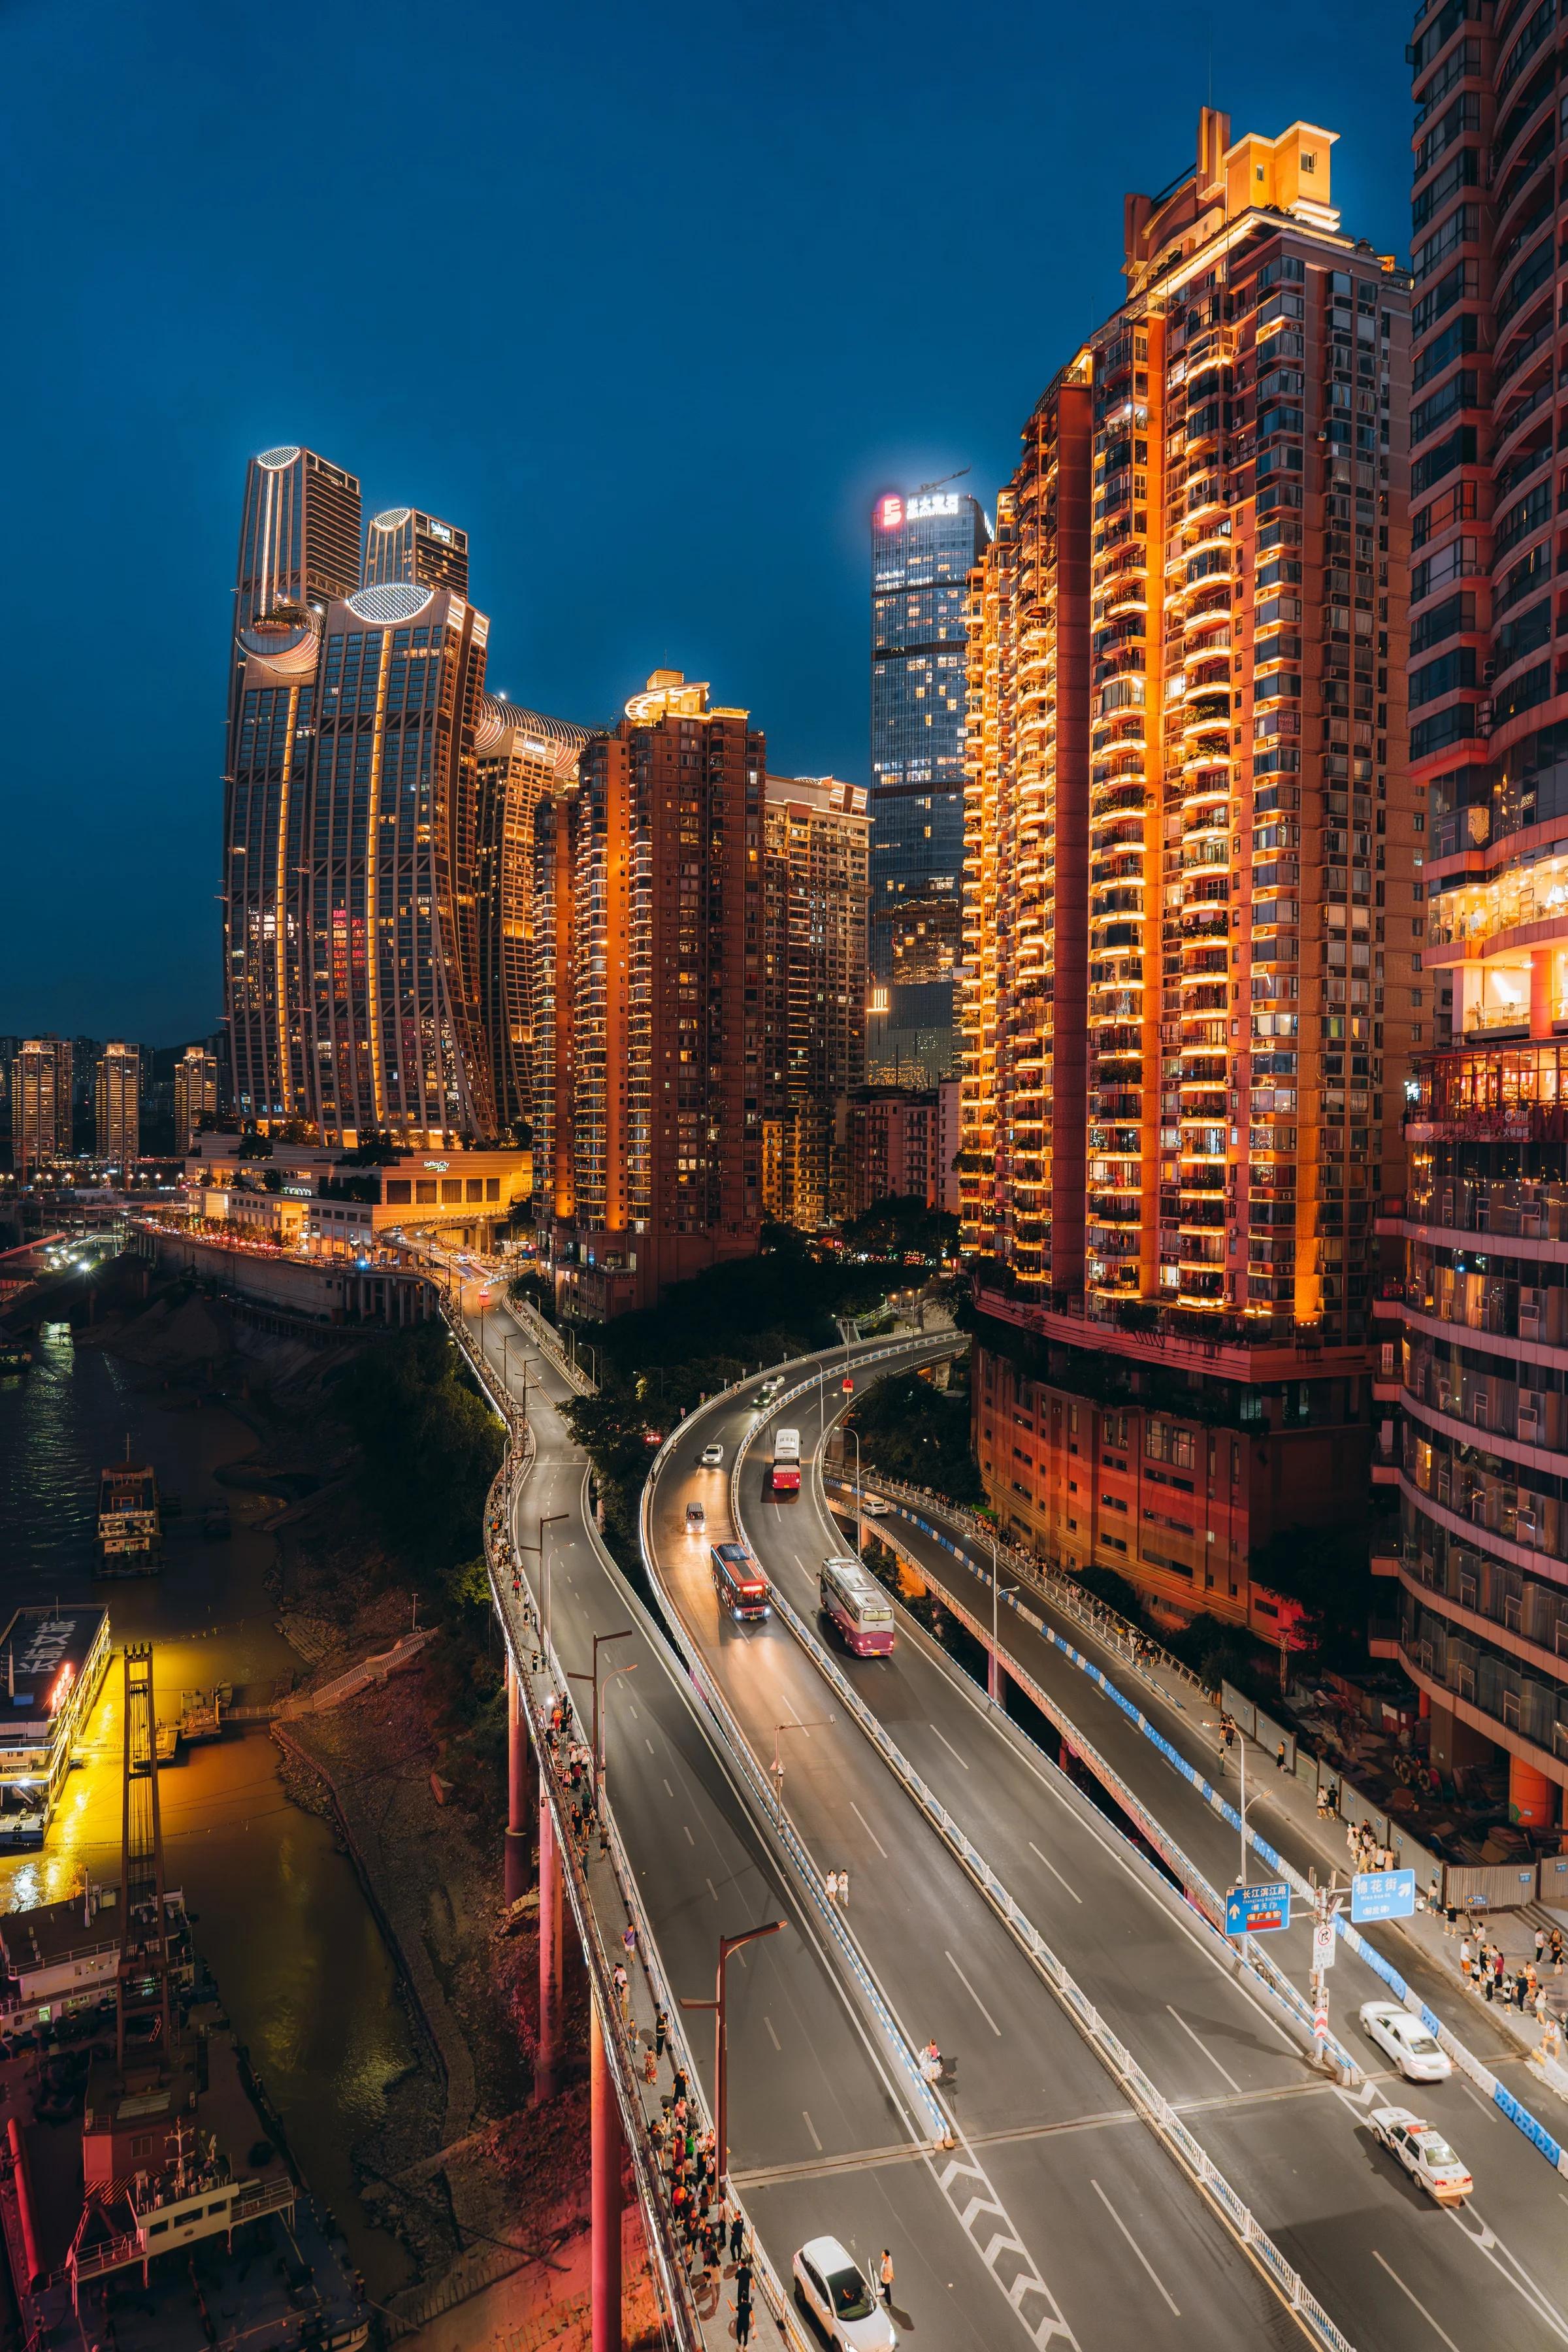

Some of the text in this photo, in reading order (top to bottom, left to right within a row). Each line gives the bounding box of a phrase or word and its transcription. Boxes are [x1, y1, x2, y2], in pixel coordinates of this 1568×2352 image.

[1243, 1886, 1286, 1899] 长江滨江路
[1356, 1878, 1397, 1895] 棉花街
